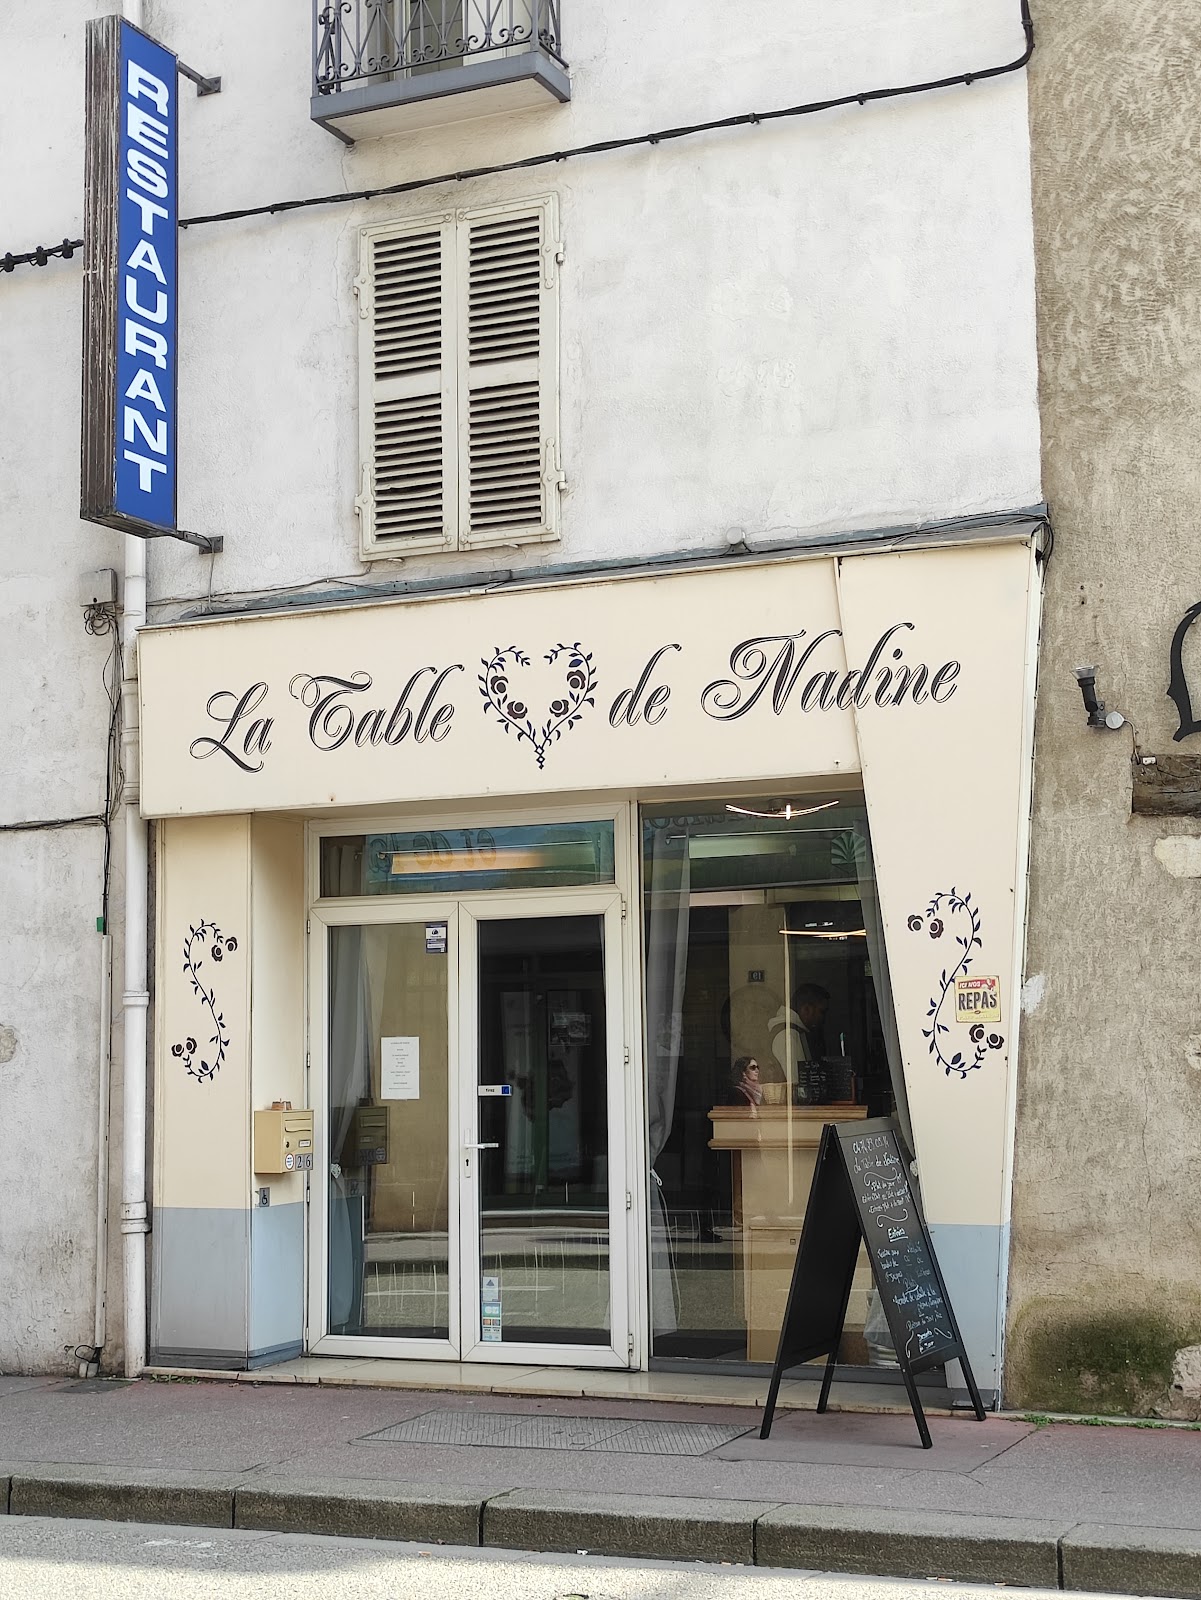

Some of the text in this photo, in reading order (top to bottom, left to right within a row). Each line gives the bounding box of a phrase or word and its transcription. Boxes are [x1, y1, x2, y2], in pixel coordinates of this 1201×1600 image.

[123, 59, 169, 493] RESTAURANT
[189, 622, 962, 774] La Table de Nadine
[958, 991, 997, 1011] REPAS
[296, 1154, 312, 1169] 26
